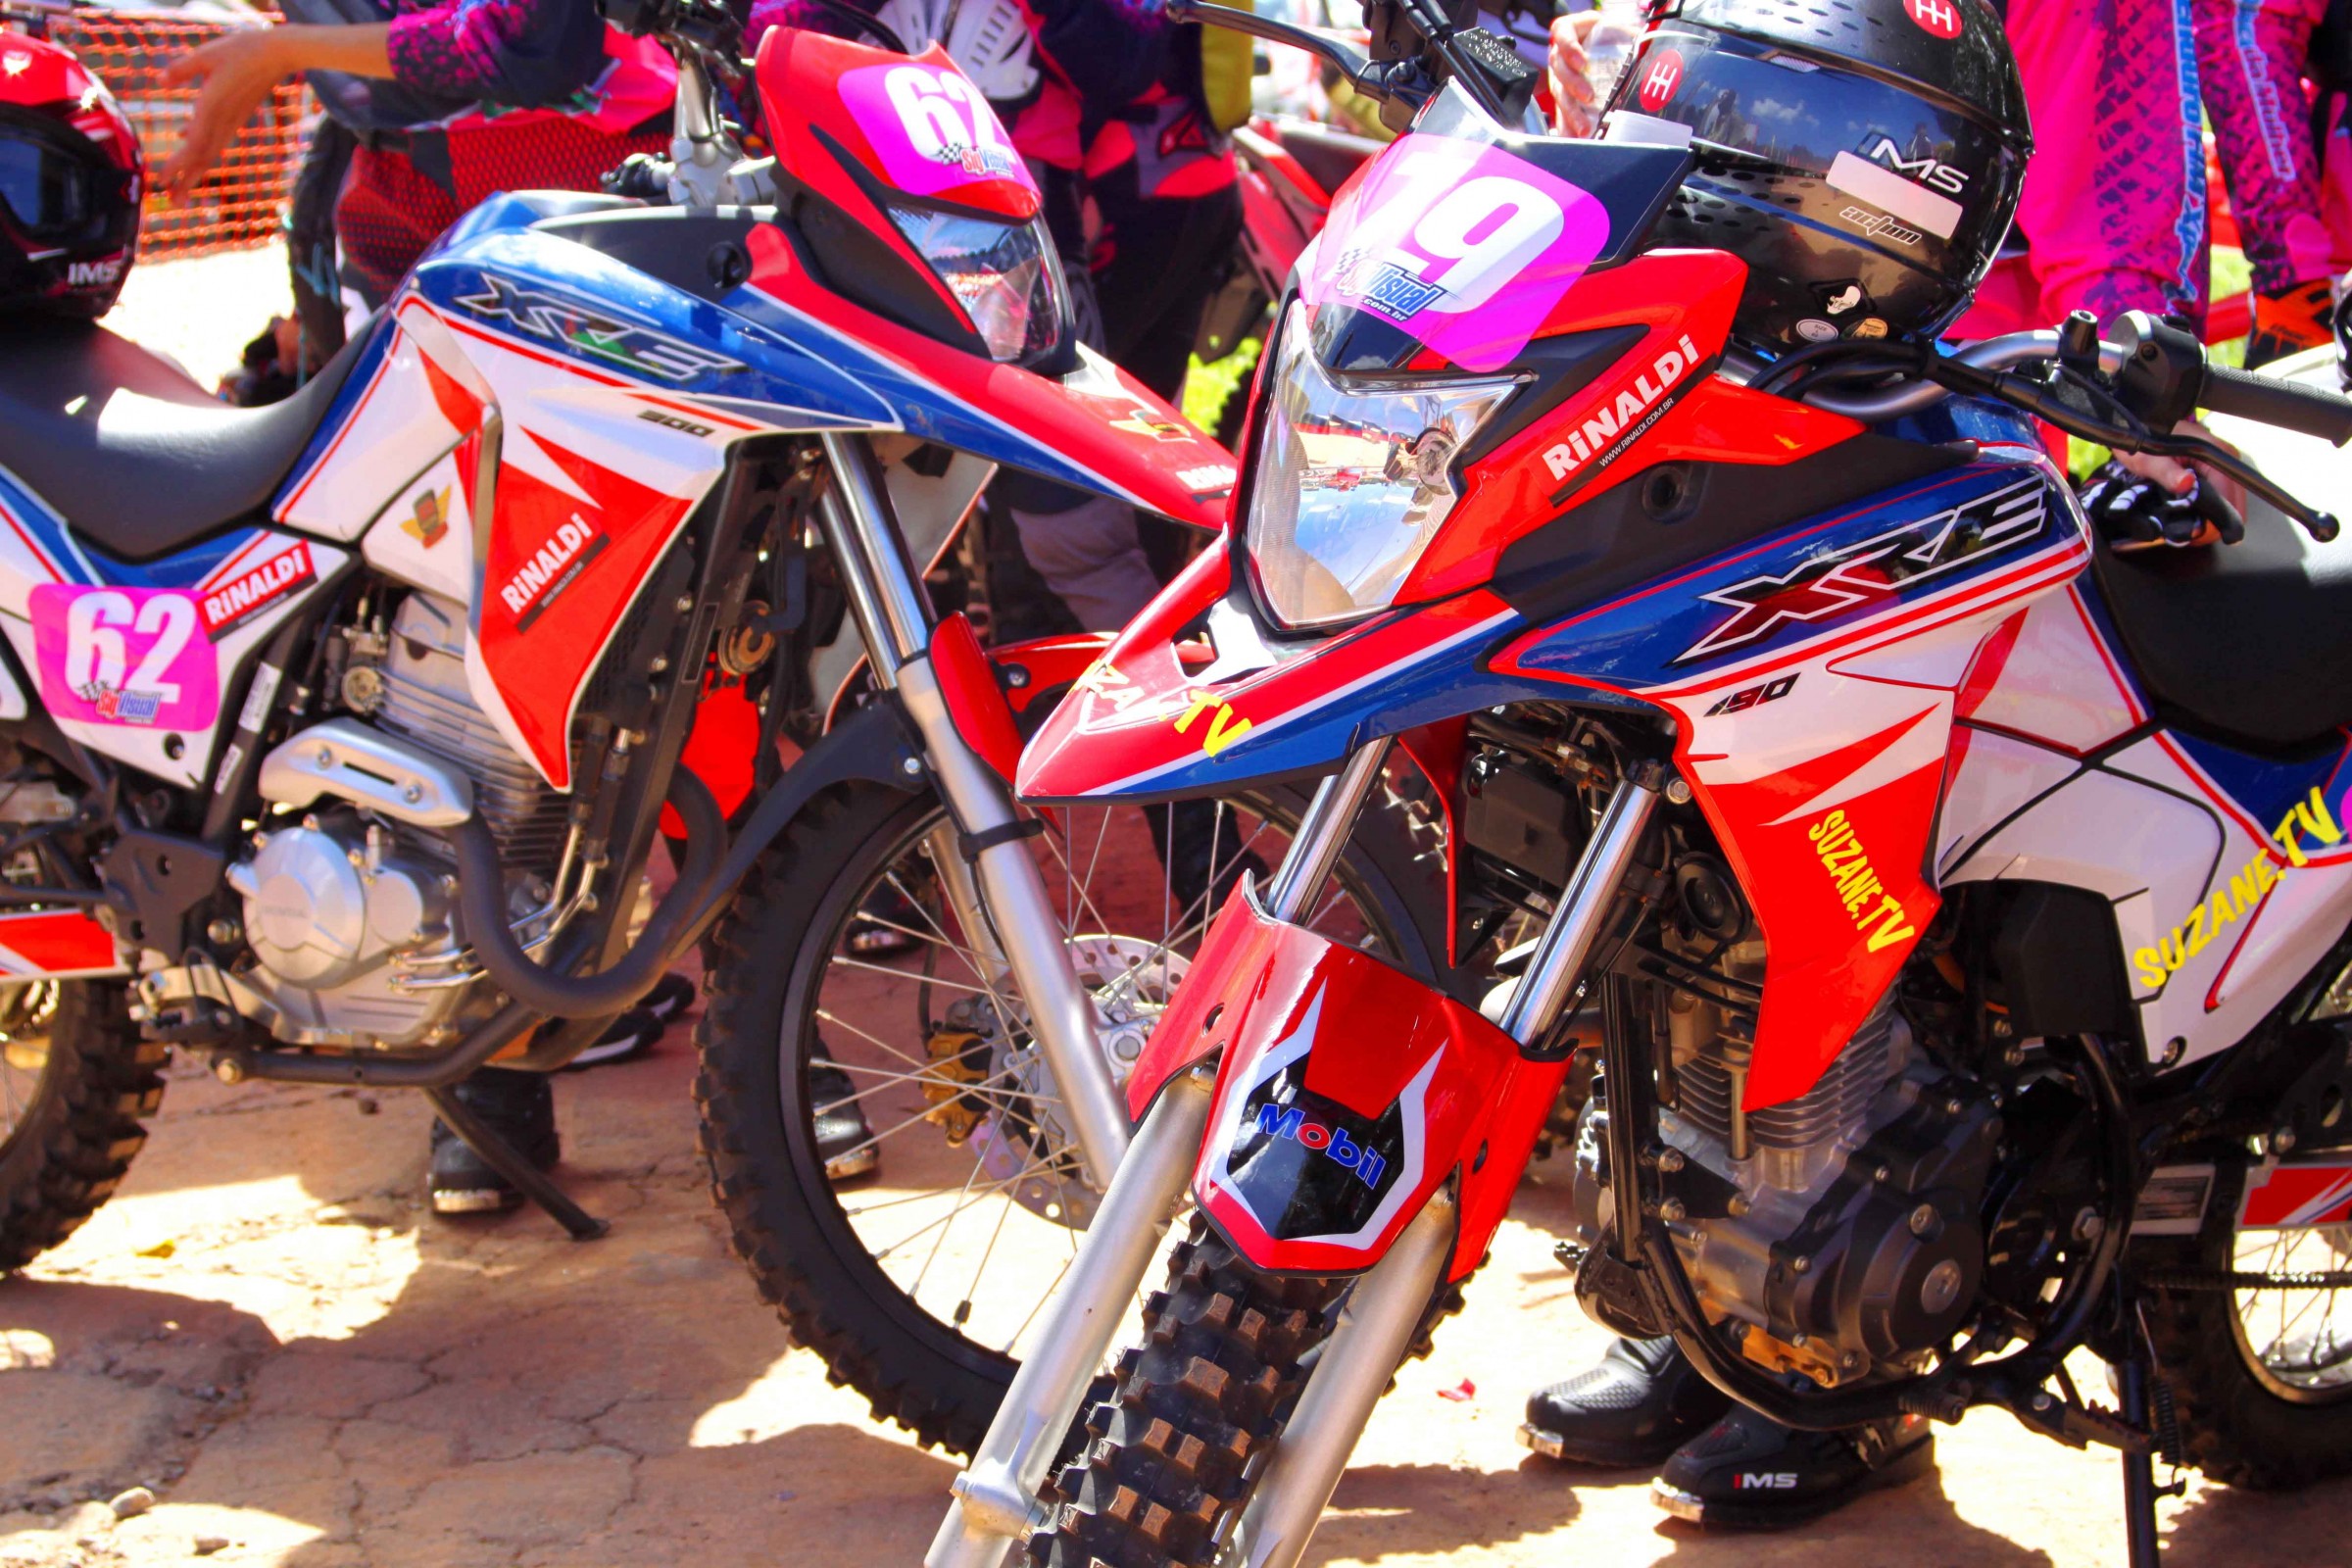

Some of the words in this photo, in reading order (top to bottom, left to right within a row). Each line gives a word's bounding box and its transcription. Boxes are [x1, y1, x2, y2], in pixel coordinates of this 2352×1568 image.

[884, 66, 1017, 165] 62
[454, 271, 752, 380] XRE
[1598, 397, 1675, 467] WWW.RINALDI.COM.BR
[1670, 473, 2048, 664] XRE
[65, 590, 196, 705] 62
[1703, 671, 1801, 718] 190
[1808, 809, 1915, 954] SUZANE.TV
[2132, 786, 2343, 989] SUZANE.TV
[1253, 1102, 1387, 1191] Mobil
[1733, 1472, 1798, 1490] IMS
